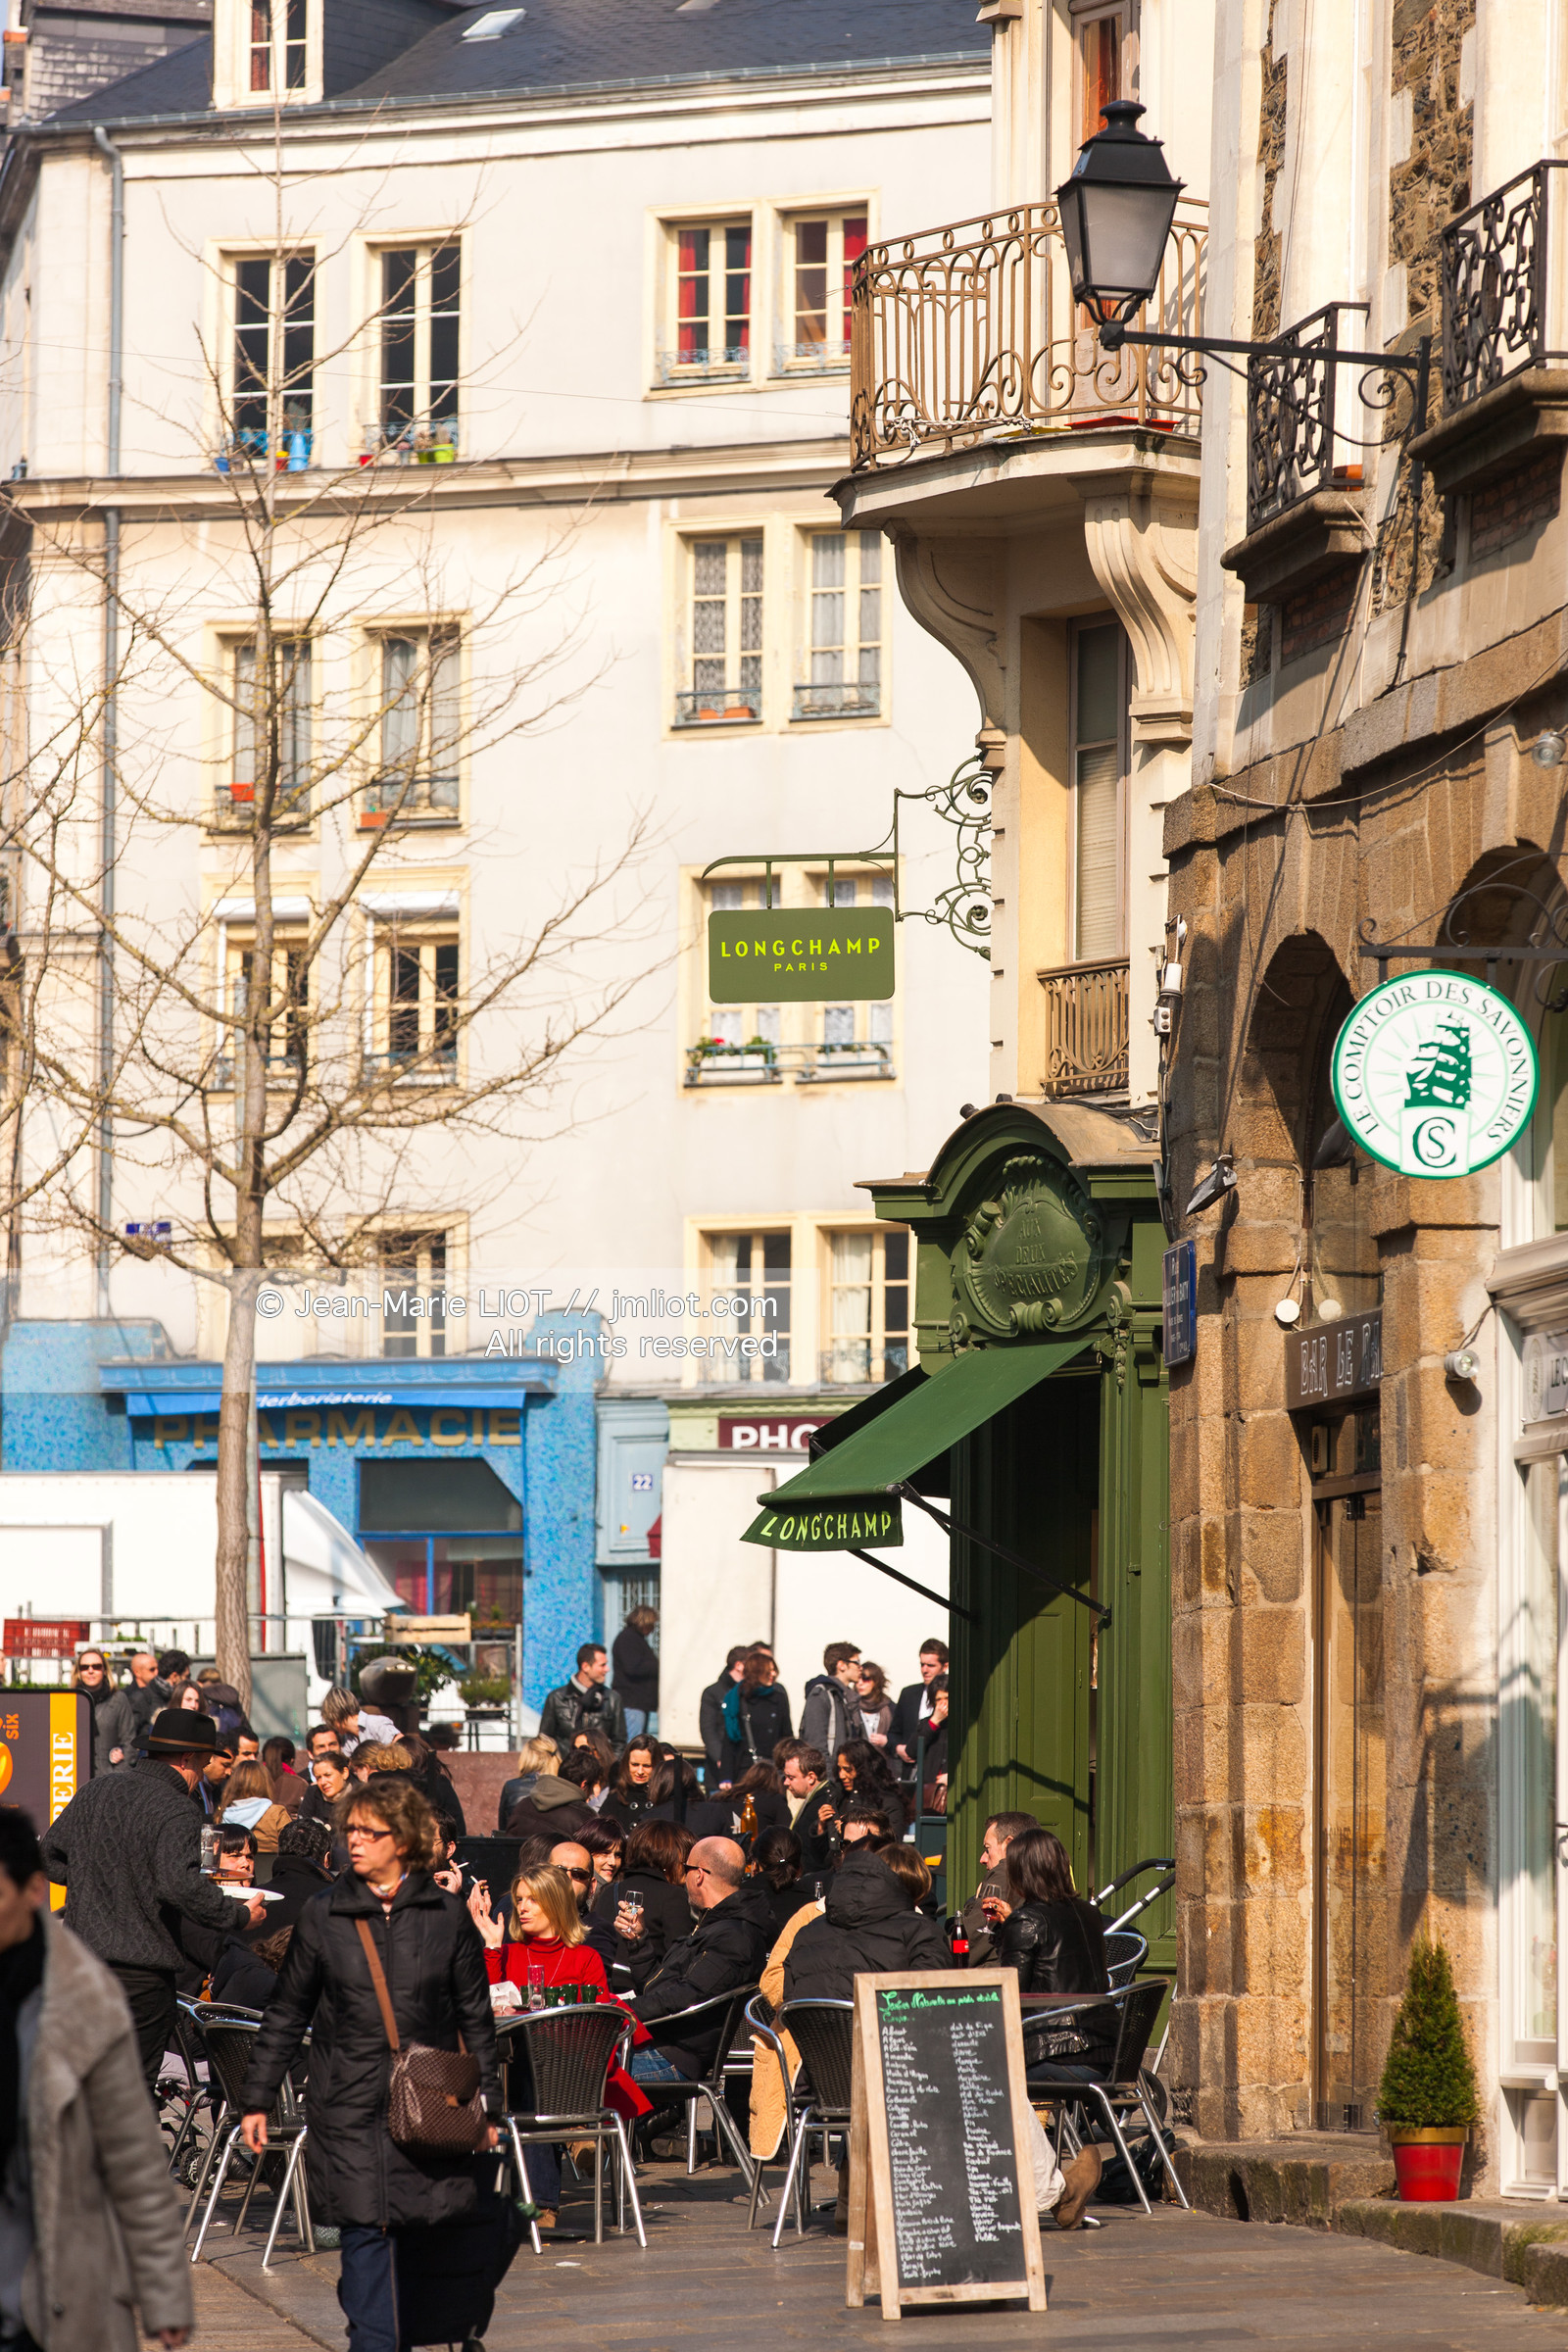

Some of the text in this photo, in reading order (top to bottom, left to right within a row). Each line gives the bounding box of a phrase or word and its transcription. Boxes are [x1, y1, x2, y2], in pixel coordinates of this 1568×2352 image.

[721, 938, 880, 957] LONGCHAMP
[774, 962, 828, 971] PARIS
[1344, 980, 1529, 1145] LE COMPTOIR DES SAVONNIERS
[1018, 1218, 1042, 1239] AUX
[1014, 1243, 1047, 1265] DEUX
[1300, 1336, 1328, 1397] BAR
[1336, 1330, 1354, 1388] LE
[634, 1475, 652, 1491] 22
[760, 1510, 891, 1542] LONGCHAMP
[2, 1713, 20, 1740] six
